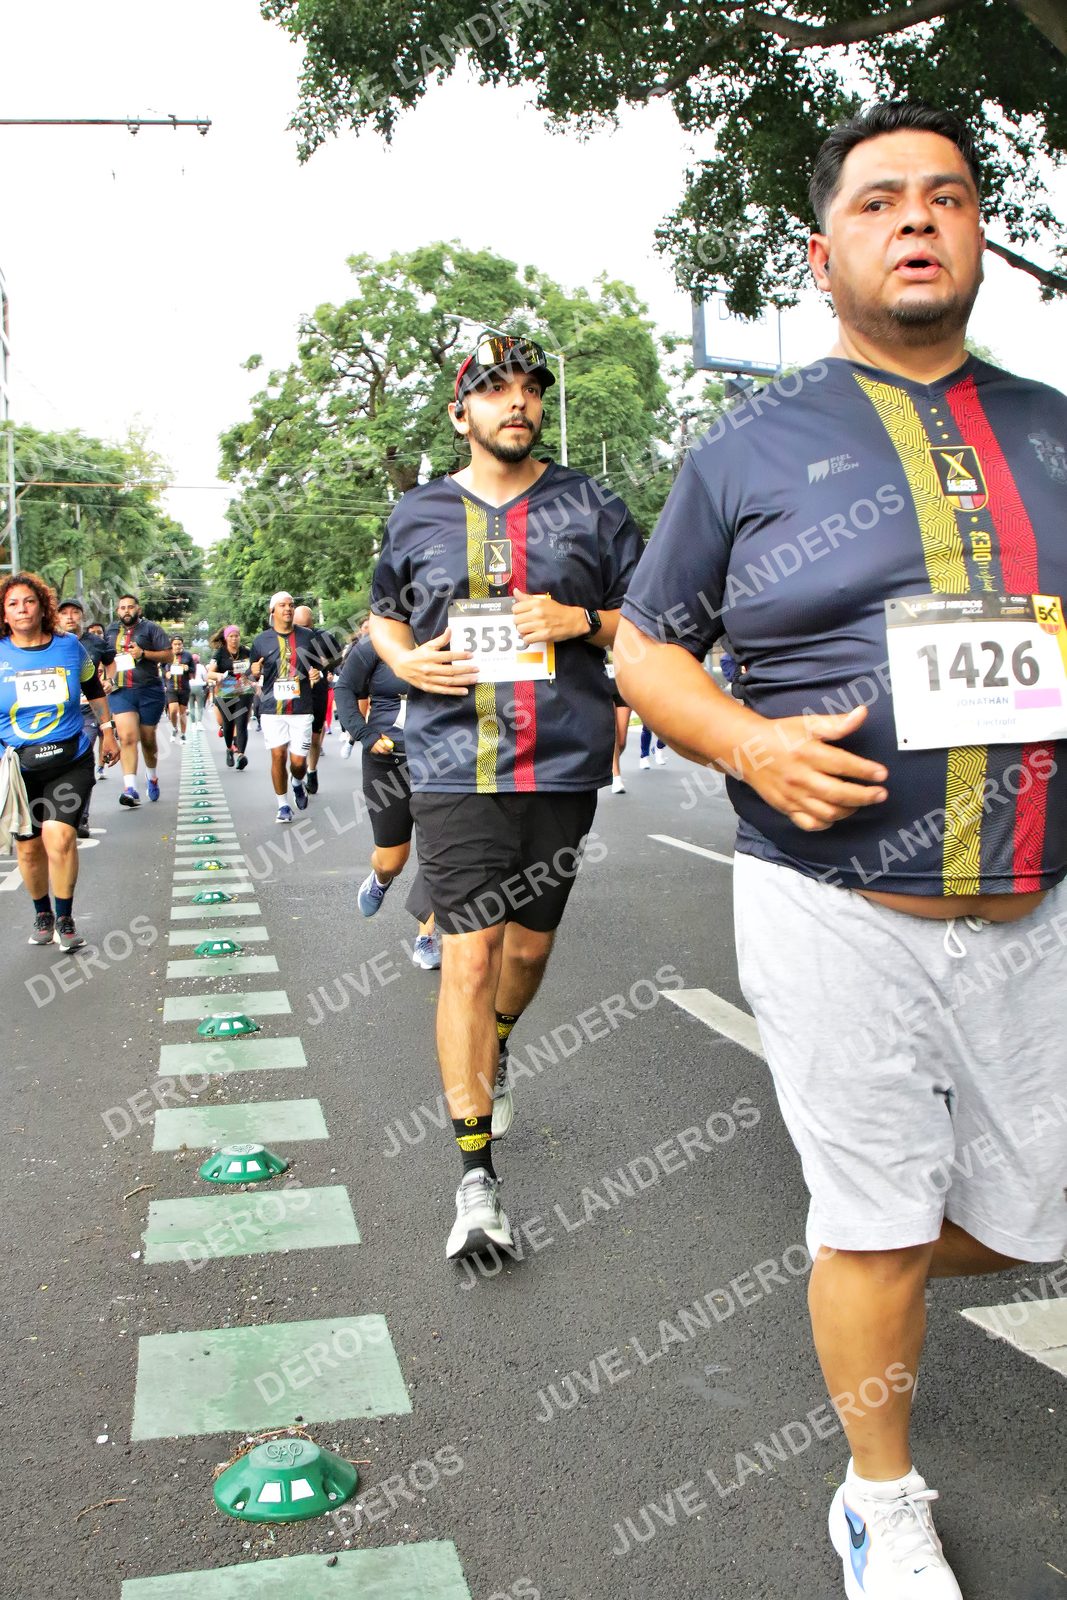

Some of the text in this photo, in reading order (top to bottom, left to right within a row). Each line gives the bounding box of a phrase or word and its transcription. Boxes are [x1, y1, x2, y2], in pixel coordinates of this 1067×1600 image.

[917, 640, 1040, 691] 1426
[23, 679, 57, 693] 4534
[956, 697, 1009, 707] JONATHAN
